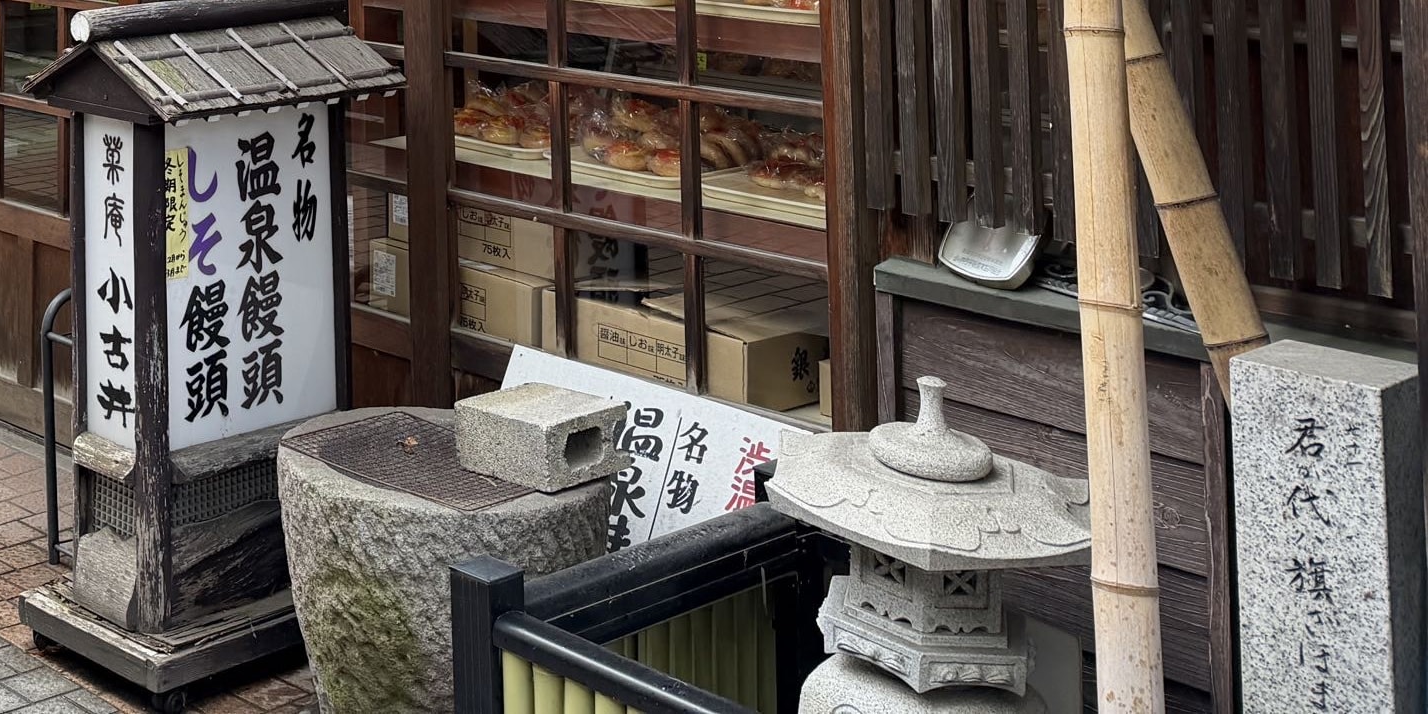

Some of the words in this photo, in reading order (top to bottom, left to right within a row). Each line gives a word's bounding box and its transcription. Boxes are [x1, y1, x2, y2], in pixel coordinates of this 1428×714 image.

[291, 113, 317, 242] 名物
[179, 145, 230, 422] しそ饅頭
[236, 131, 284, 410] 温泉饅頭
[482, 243, 512, 260] 75枚入
[97, 266, 135, 428] 小古井
[666, 421, 709, 515] 名物
